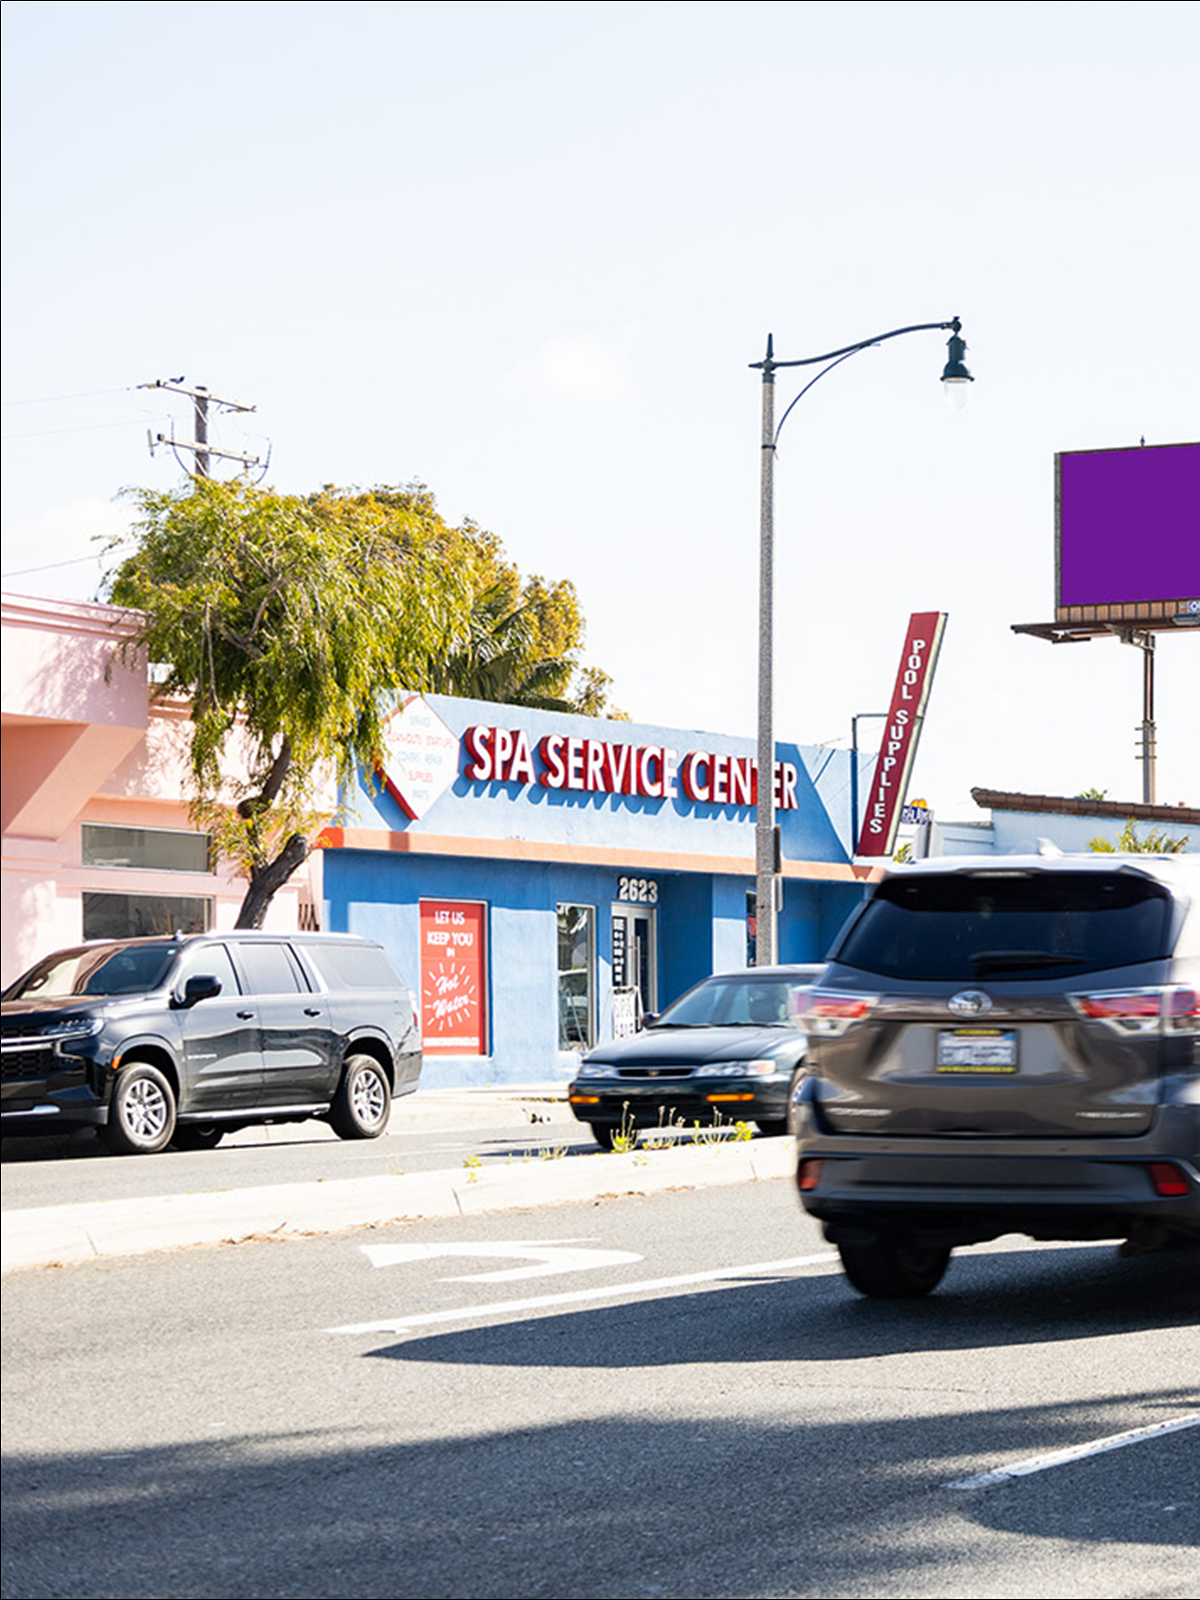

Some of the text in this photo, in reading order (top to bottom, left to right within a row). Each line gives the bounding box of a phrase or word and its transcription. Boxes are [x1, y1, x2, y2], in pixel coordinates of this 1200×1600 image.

[902, 638, 926, 700] POOL
[467, 724, 798, 810] SPA SERVICE CENER
[869, 709, 909, 834] SUPPLIES
[618, 876, 658, 903] 2623
[435, 910, 466, 925] LET US
[426, 931, 474, 947] KEEP YOU
[446, 948, 455, 957] IN
[435, 974, 460, 996] Hot
[432, 994, 469, 1019] Water
